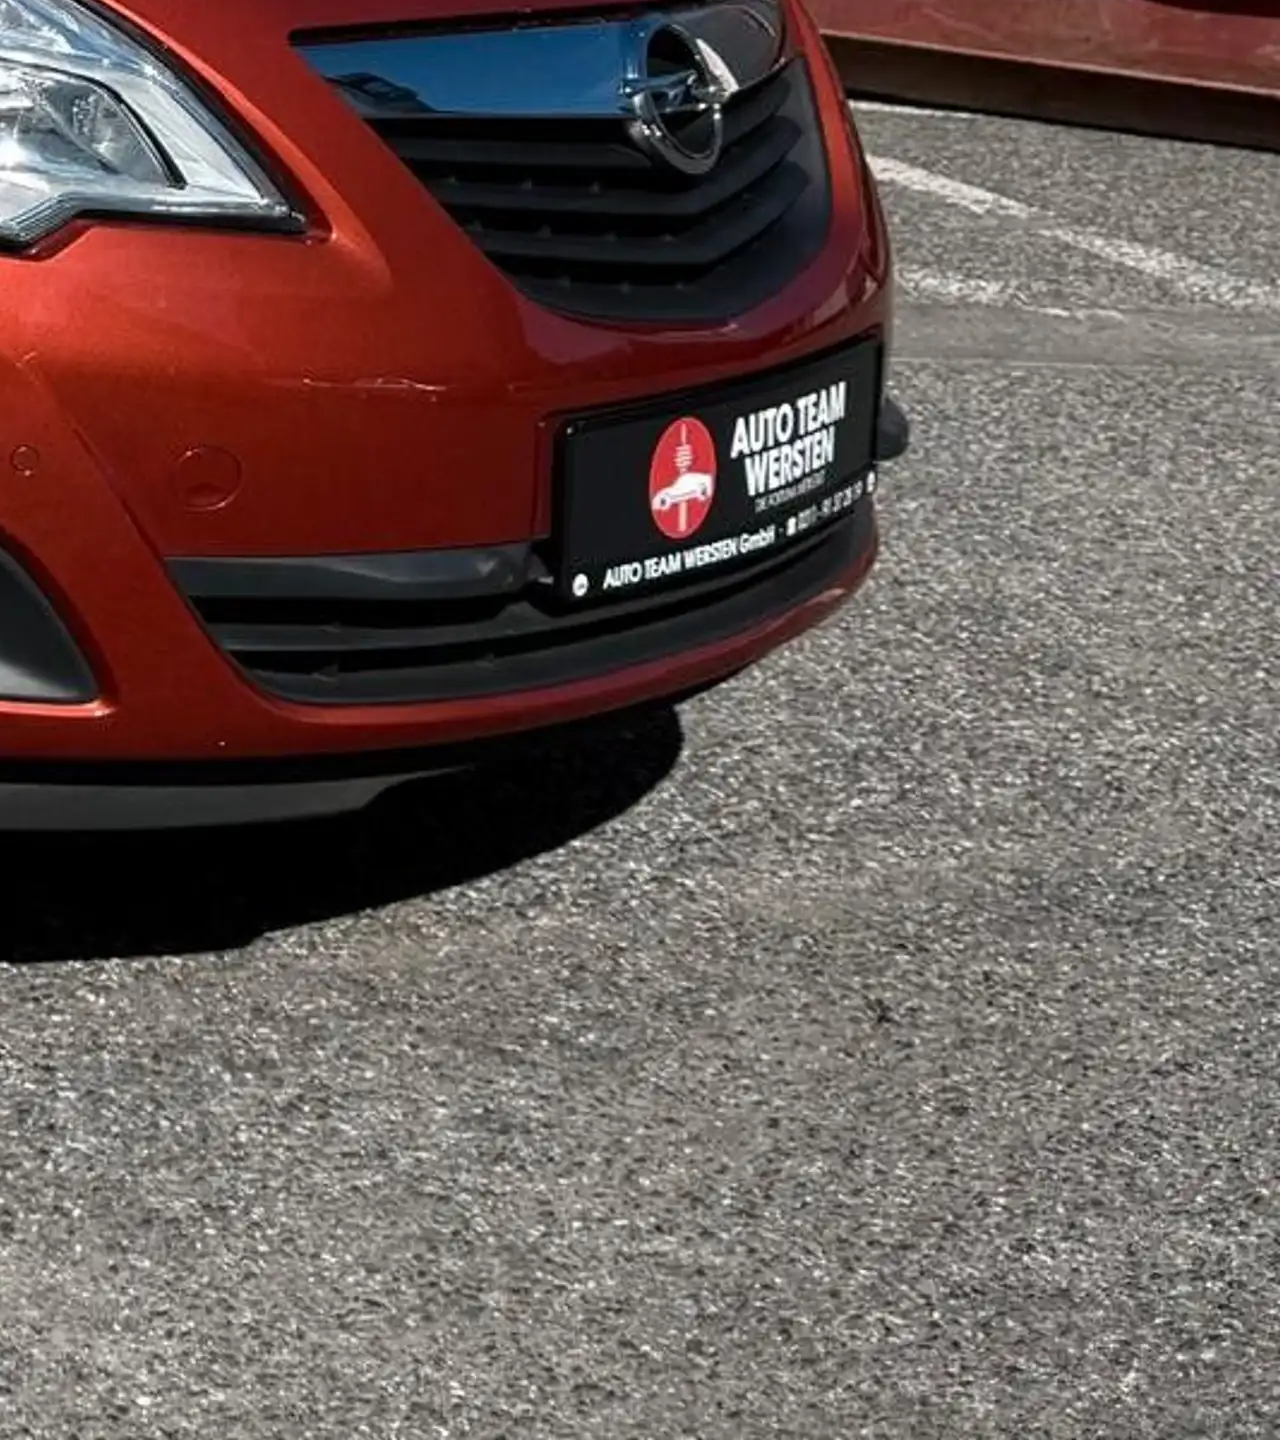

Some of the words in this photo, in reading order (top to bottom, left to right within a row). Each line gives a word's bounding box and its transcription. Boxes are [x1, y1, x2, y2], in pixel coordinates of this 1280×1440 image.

[730, 403, 794, 459] AUTO
[796, 381, 847, 436] TEAM
[744, 425, 836, 497] WERSTEN
[602, 561, 642, 590] AUTO
[644, 551, 682, 580] TEAM
[683, 536, 740, 569] WERSTEN
[740, 524, 776, 555] GmbH
